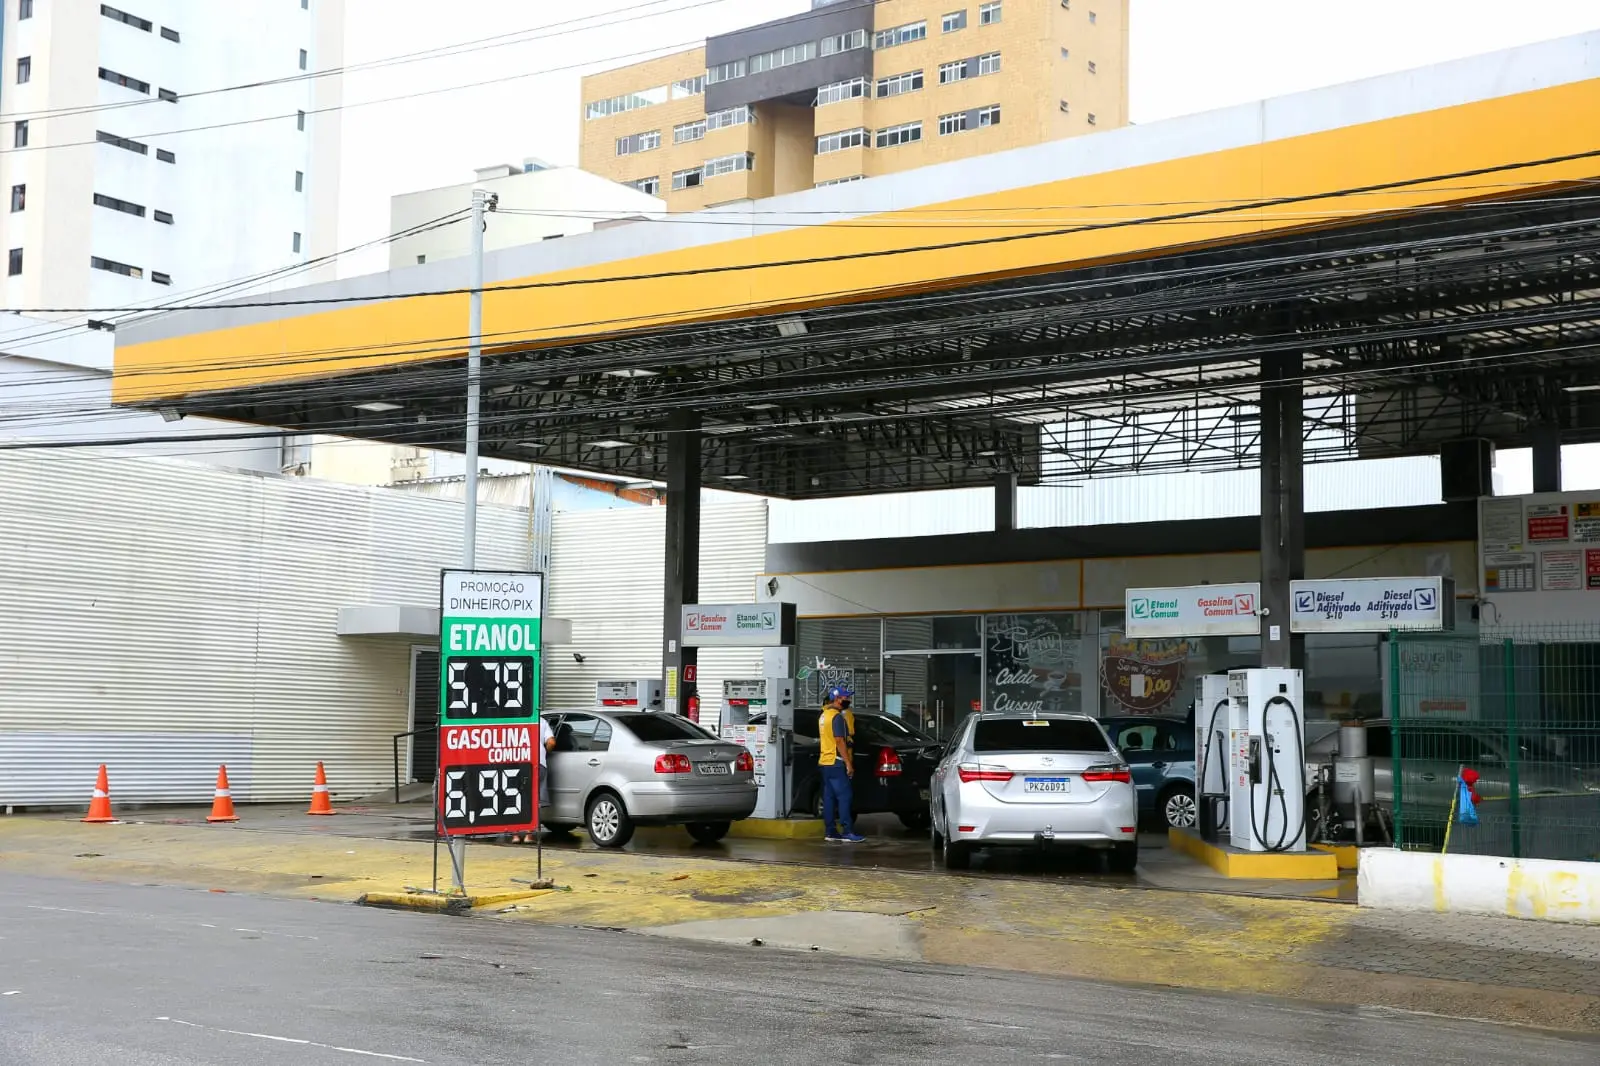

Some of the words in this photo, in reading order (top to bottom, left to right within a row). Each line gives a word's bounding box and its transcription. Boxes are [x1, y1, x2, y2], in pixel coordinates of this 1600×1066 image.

[460, 580, 525, 596] PROMOÇÃO
[1316, 591, 1345, 603] Diesel
[1383, 589, 1413, 601] Diesel
[450, 597, 533, 611] DINHEIRO/PIX
[1150, 599, 1178, 610] Etanol
[1197, 597, 1233, 608] Gasolina
[1316, 601, 1362, 613] Aditivado
[1366, 600, 1413, 612] Aditivado
[736, 613, 759, 622] Etanol
[1150, 609, 1179, 618] Comum
[1203, 607, 1234, 617] Comum
[1325, 611, 1343, 621] S-10
[1380, 610, 1399, 620] S-10
[700, 614, 727, 624] Gasolina
[736, 621, 762, 629] Comum
[700, 622, 722, 631] Comum
[449, 623, 536, 652] ETANOL
[995, 667, 1040, 686] Caldo
[448, 661, 523, 716] 5,79
[447, 727, 531, 750] GASOLINA
[488, 747, 531, 763] COMUM
[1029, 782, 1066, 792] PKZ6D91
[446, 768, 522, 825] 6,95
